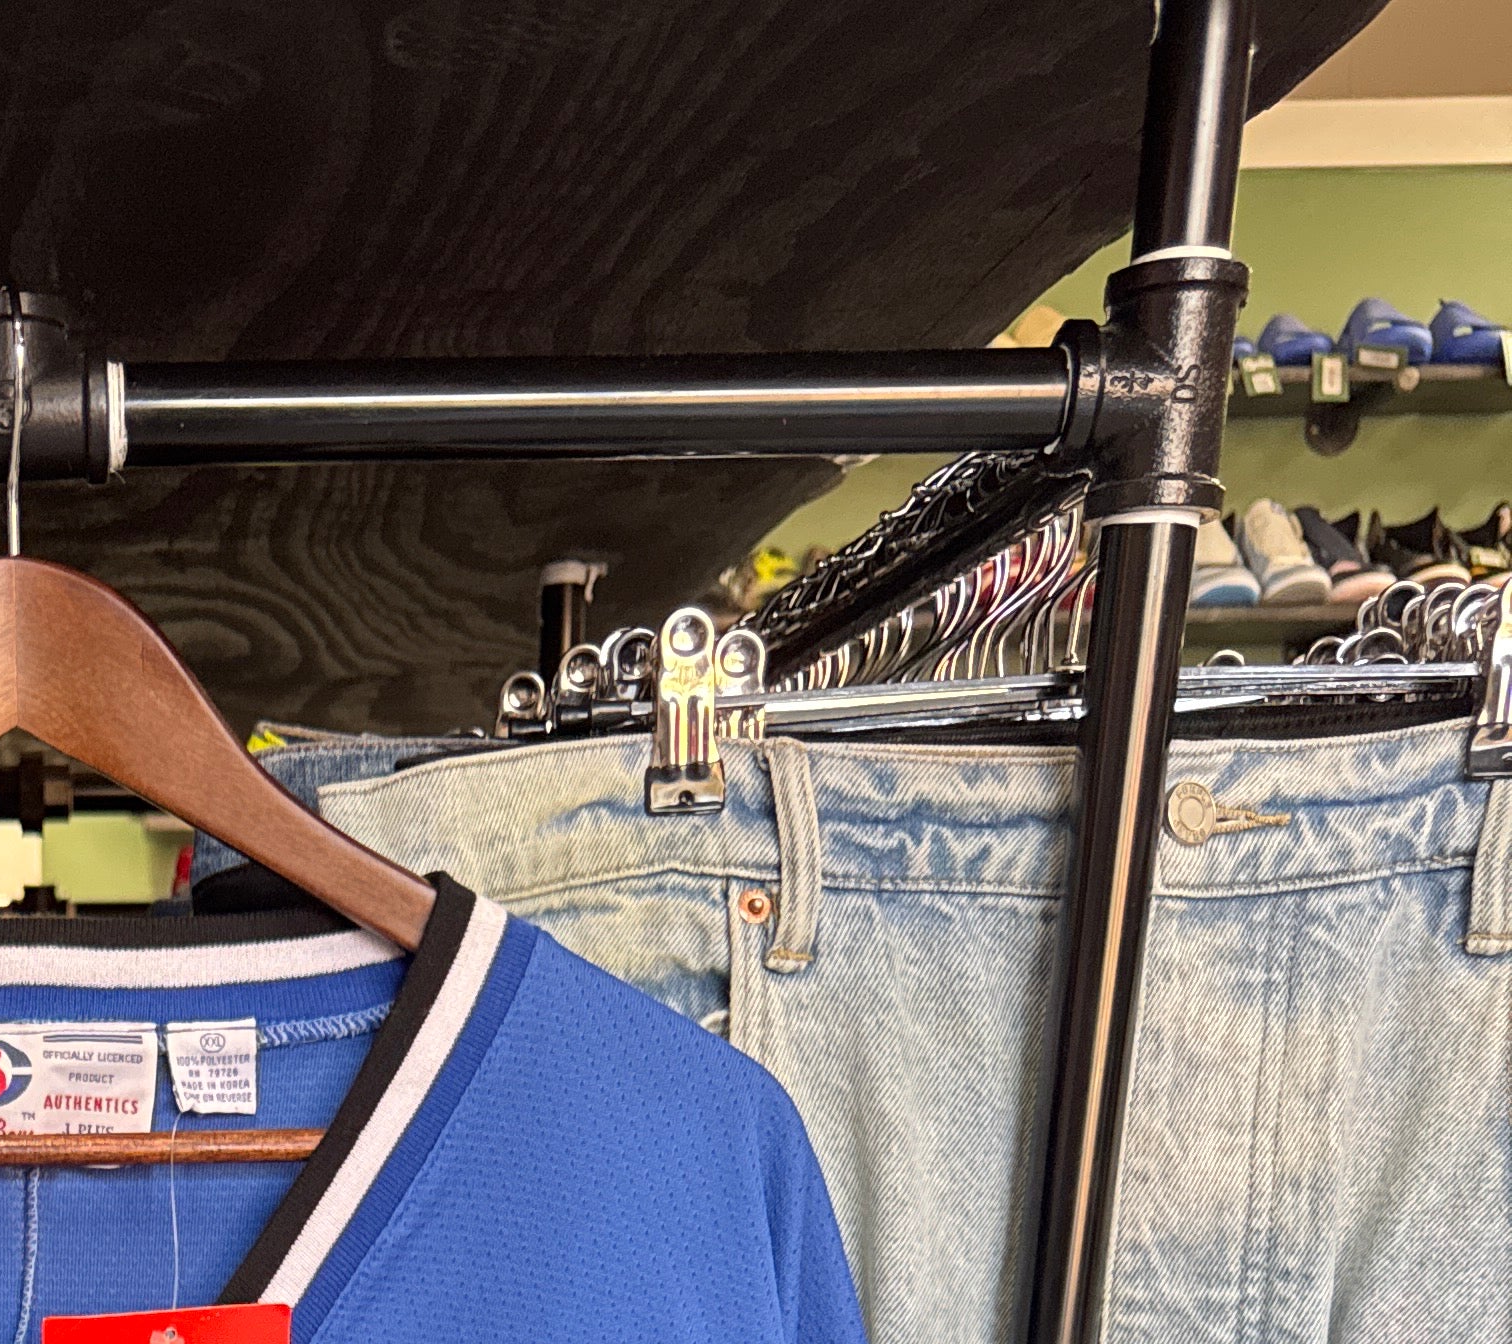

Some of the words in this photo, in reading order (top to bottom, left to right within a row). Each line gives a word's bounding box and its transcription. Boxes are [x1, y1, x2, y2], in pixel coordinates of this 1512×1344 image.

[202, 1035, 222, 1048] XXL
[42, 1050, 94, 1062] OFFICIALLY
[97, 1052, 144, 1065] LICENCED
[68, 1072, 115, 1085] PRODUCT
[207, 1081, 217, 1091] IN
[220, 1078, 251, 1091] KOREA
[44, 1094, 139, 1115] AUTHENTICS
